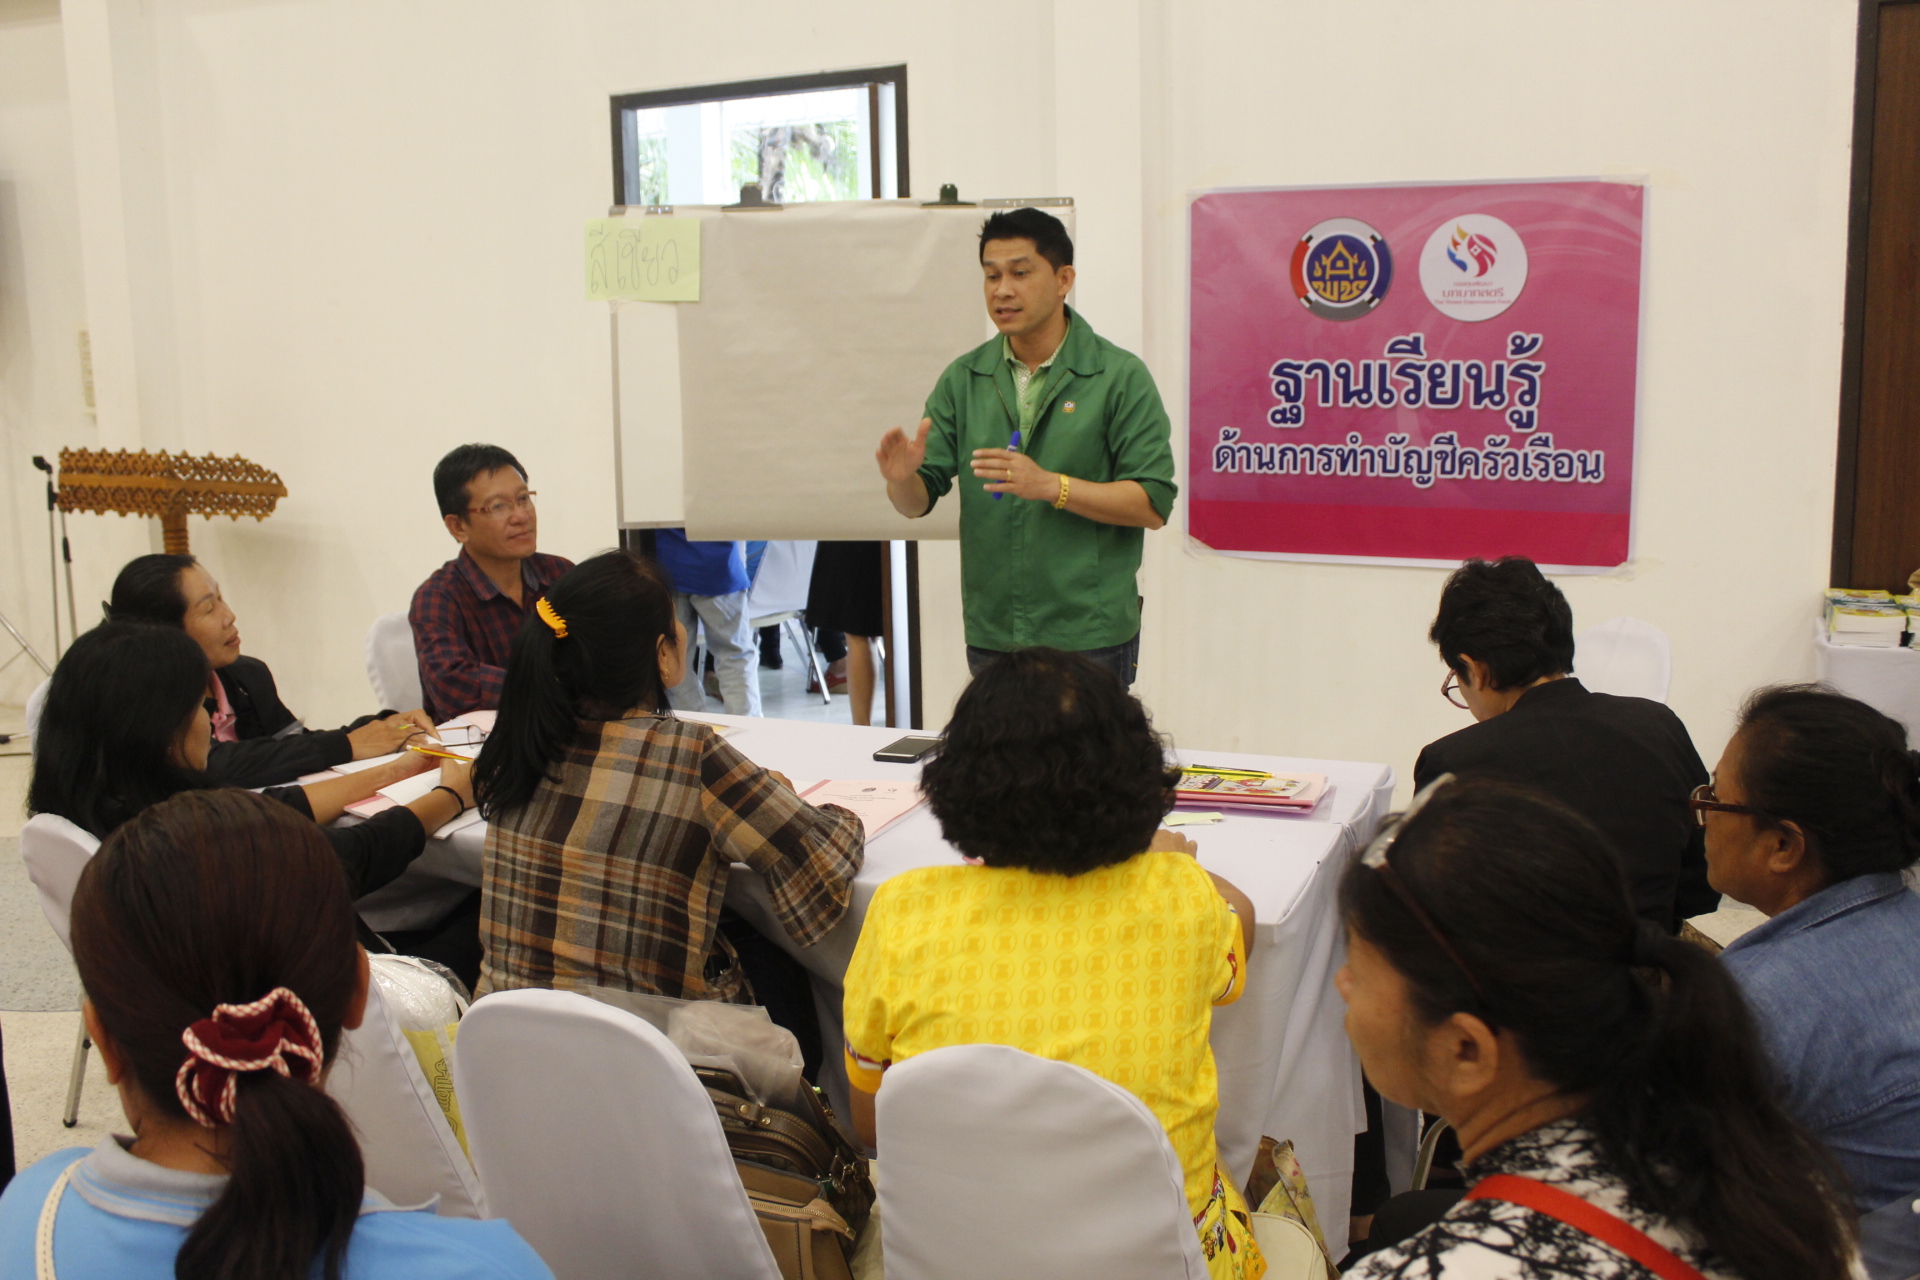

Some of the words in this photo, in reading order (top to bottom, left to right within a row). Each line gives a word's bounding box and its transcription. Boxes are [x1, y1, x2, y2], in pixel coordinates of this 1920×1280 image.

[589, 223, 679, 293] สีเขียว
[1269, 332, 1545, 432] ฐานเรียนรู้
[1213, 427, 1604, 487] ด้านการทำบัญชีครัวเรือน
